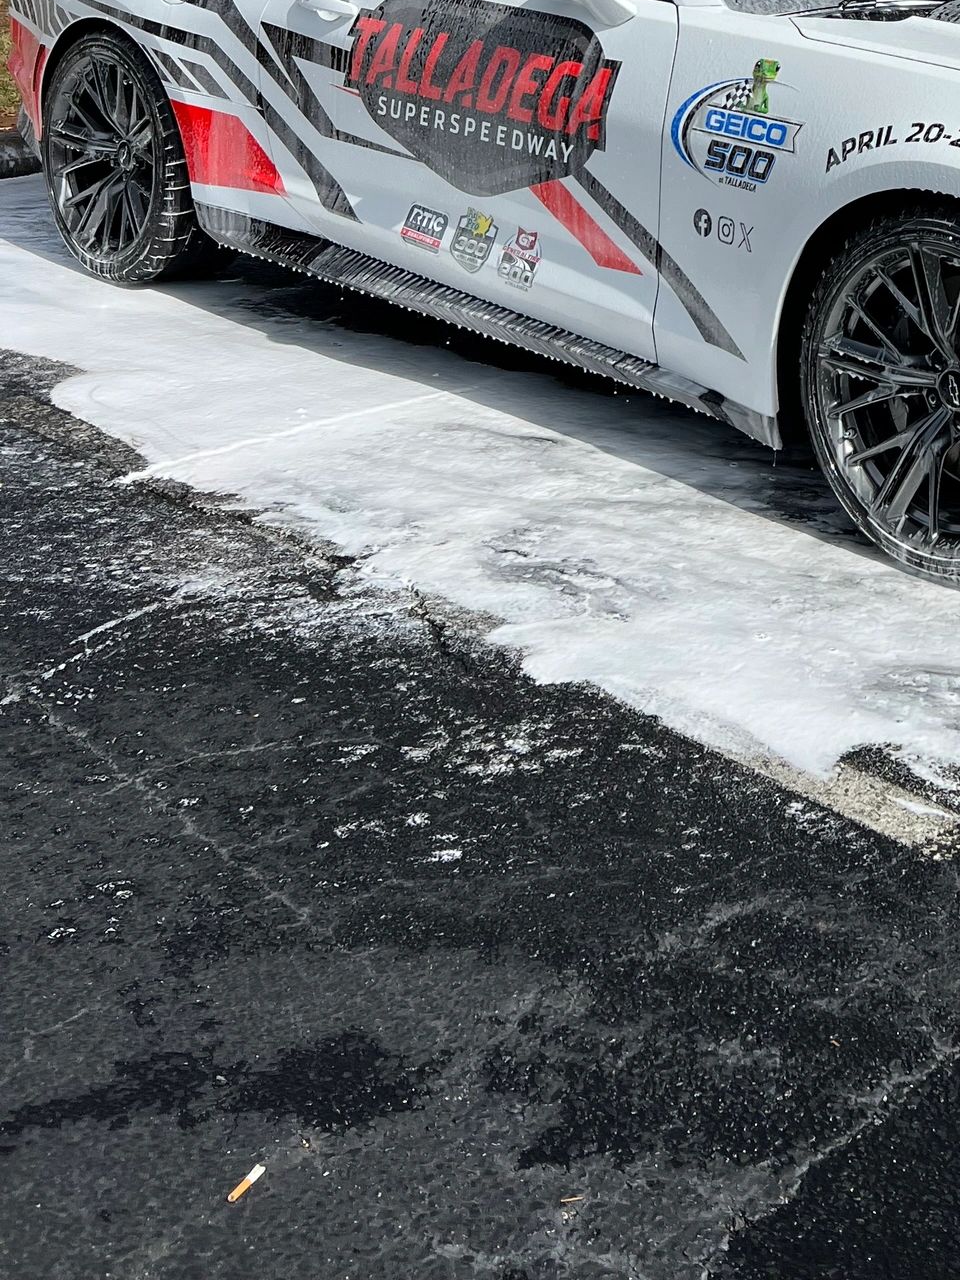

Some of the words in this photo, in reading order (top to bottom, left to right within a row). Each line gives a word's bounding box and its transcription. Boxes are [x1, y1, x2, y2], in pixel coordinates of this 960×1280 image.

[349, 16, 613, 141] TALLADEGA
[377, 96, 575, 164] SUPERSPEEDWAY
[705, 109, 788, 146] GEICO
[704, 139, 776, 183] 500
[825, 124, 898, 174] APRIL
[724, 176, 757, 192] TALLADEGA
[409, 207, 445, 232] RTIC
[454, 236, 488, 257] 300
